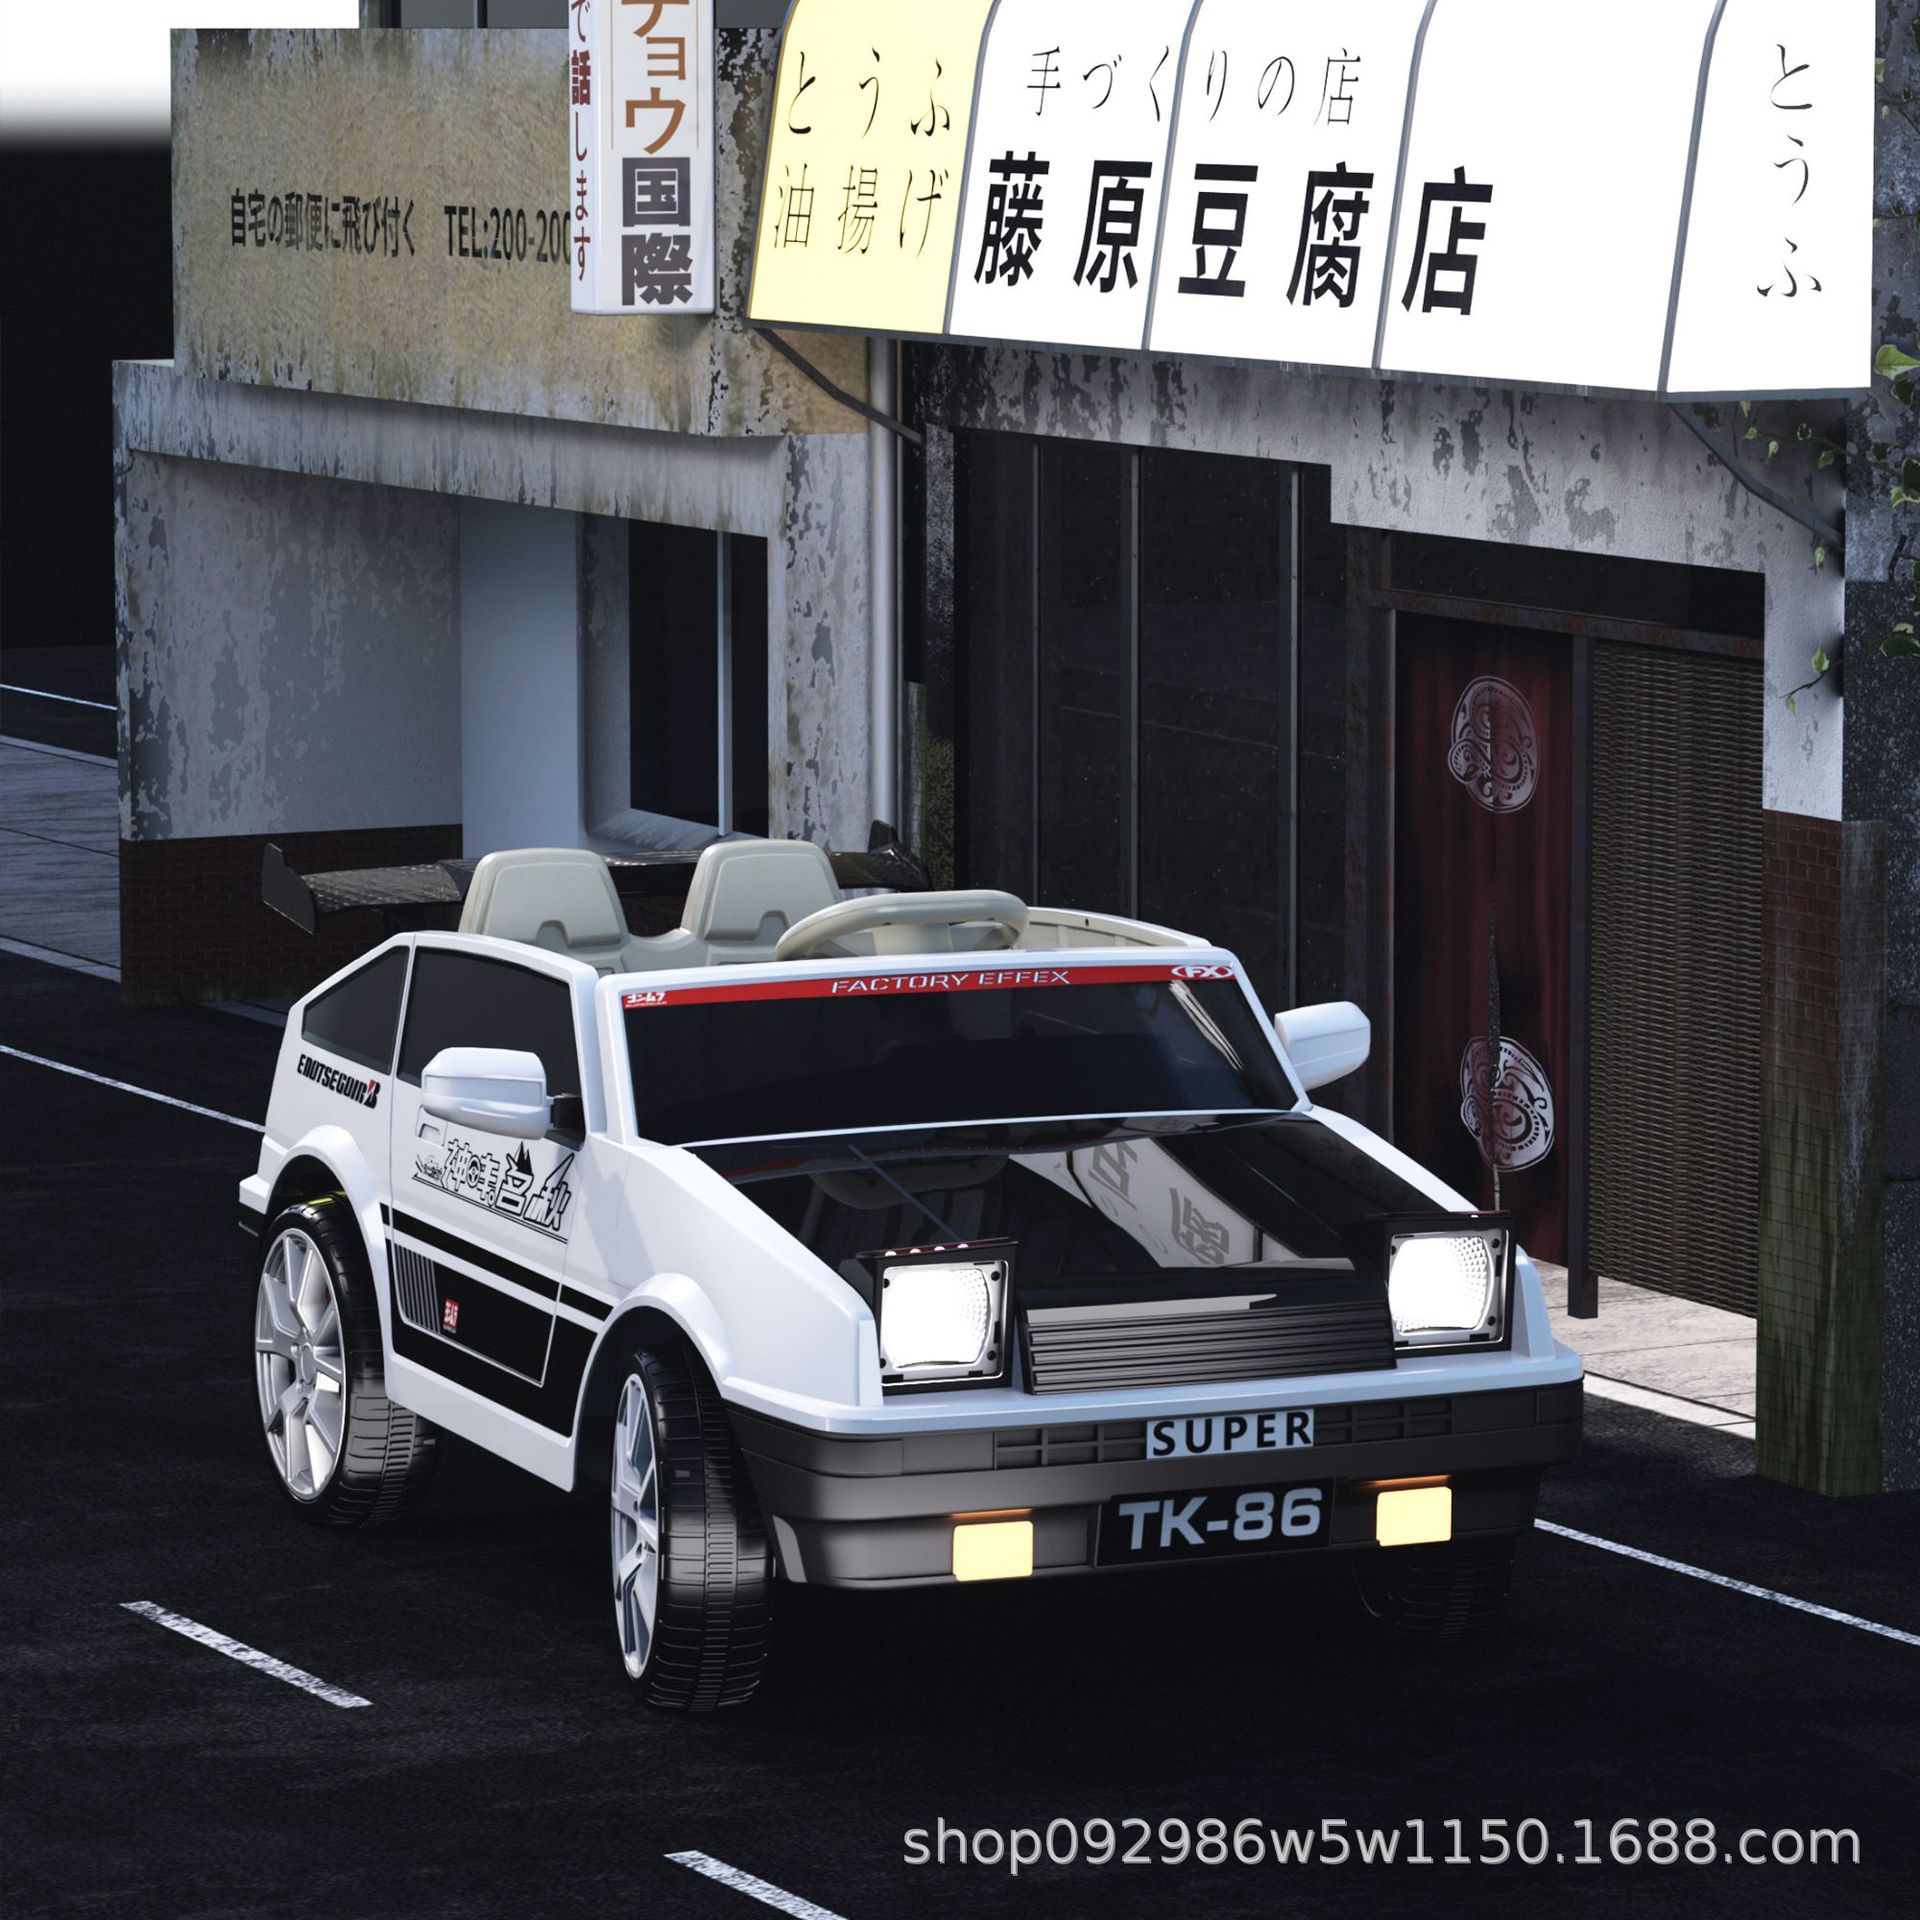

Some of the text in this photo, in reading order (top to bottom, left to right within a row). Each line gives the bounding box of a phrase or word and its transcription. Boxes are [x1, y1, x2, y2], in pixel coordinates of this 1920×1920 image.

[788, 46, 950, 138] とうふ
[1026, 45, 1362, 126] 手づくりの店
[773, 163, 950, 258] 油揚げ
[1756, 43, 1822, 298] とうふ
[231, 187, 414, 257] 自宅の郵便に飛び付く
[973, 150, 1494, 316] 藤原豆腐店
[831, 970, 1071, 994] FACTORY EFFEX
[1152, 1411, 1312, 1456] SUPER
[1119, 1487, 1323, 1550] TK-86
